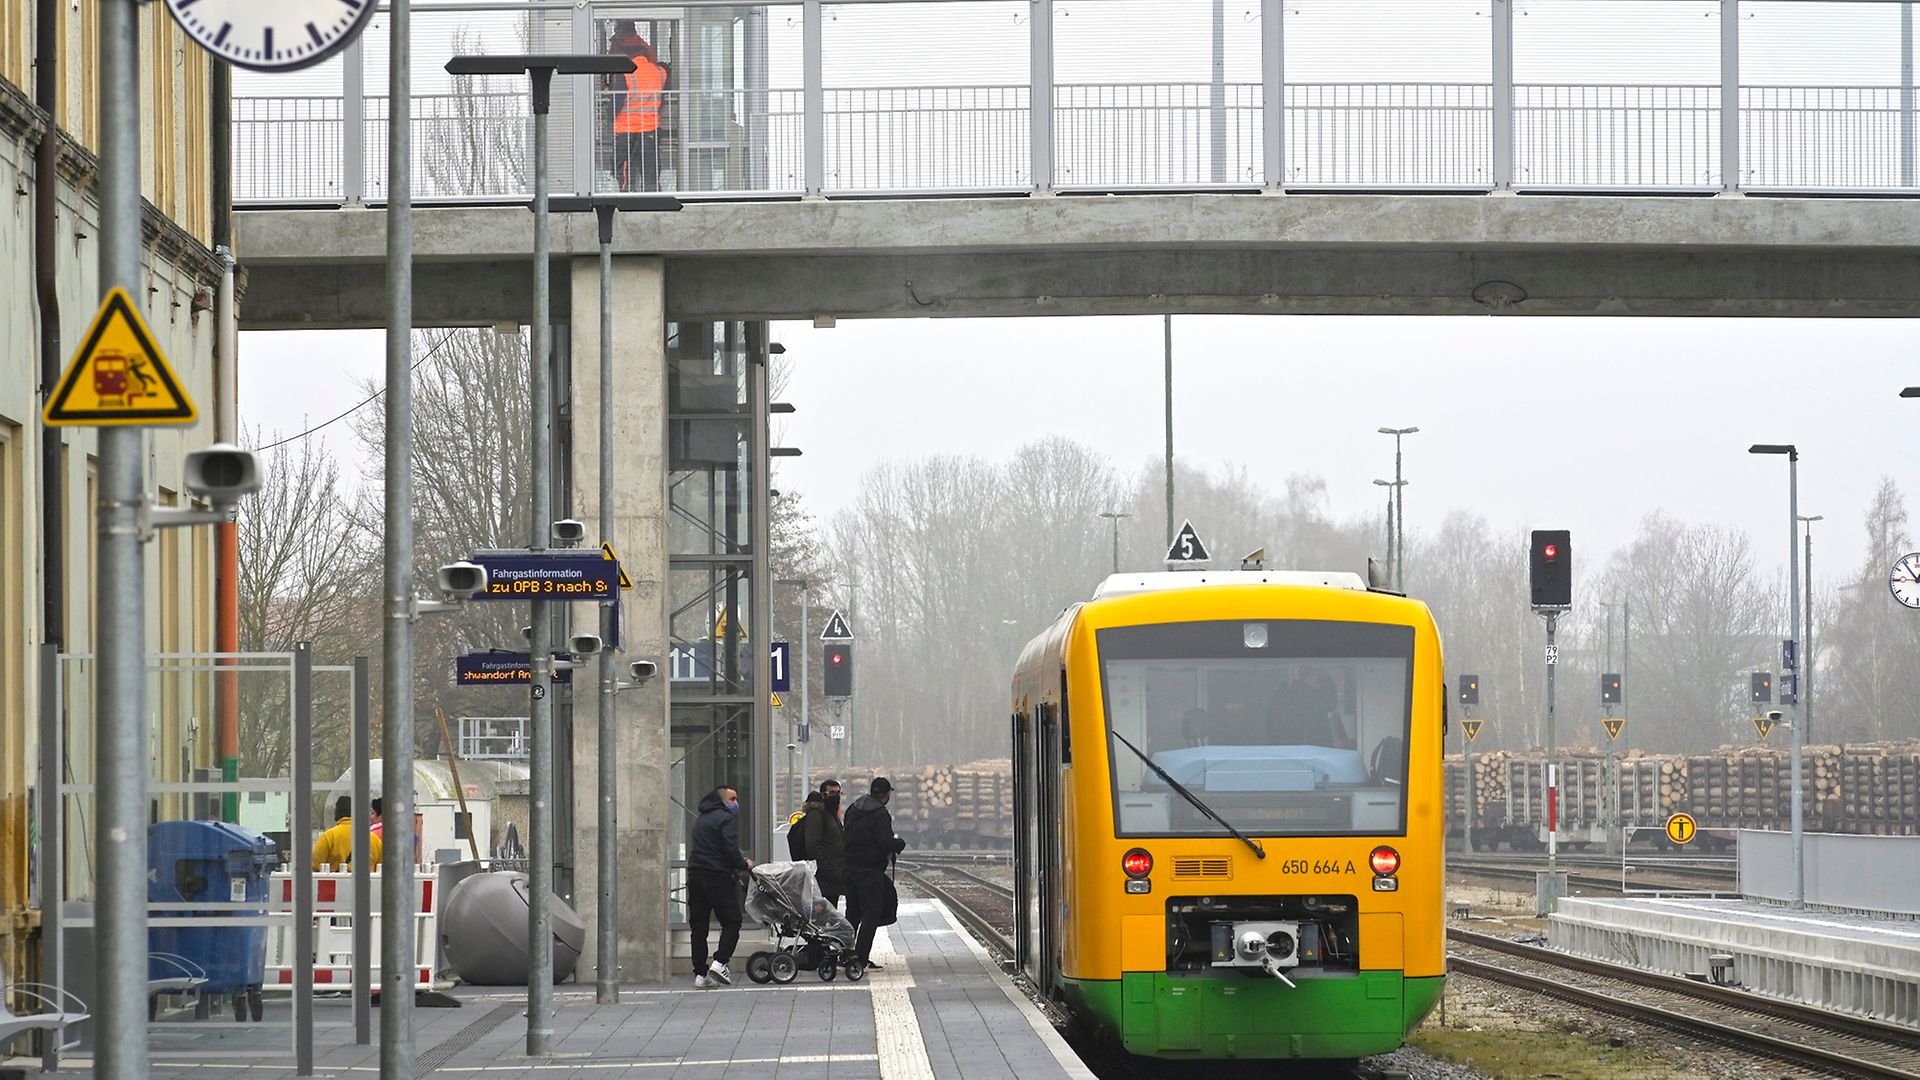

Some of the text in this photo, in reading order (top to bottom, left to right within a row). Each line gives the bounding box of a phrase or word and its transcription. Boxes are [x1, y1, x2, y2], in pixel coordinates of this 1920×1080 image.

[1181, 533, 1194, 559] 5
[492, 568, 583, 580] Fahrgastinformation
[492, 583, 510, 593] zu
[543, 580, 553, 593] 3
[556, 580, 592, 593] nach
[833, 618, 842, 636] 4
[1546, 645, 1558, 655] 79
[770, 646, 783, 680] 1
[1546, 654, 1558, 664] P2
[481, 662, 531, 671] Fahrgastinform
[1281, 860, 1356, 875] 650 664 A
